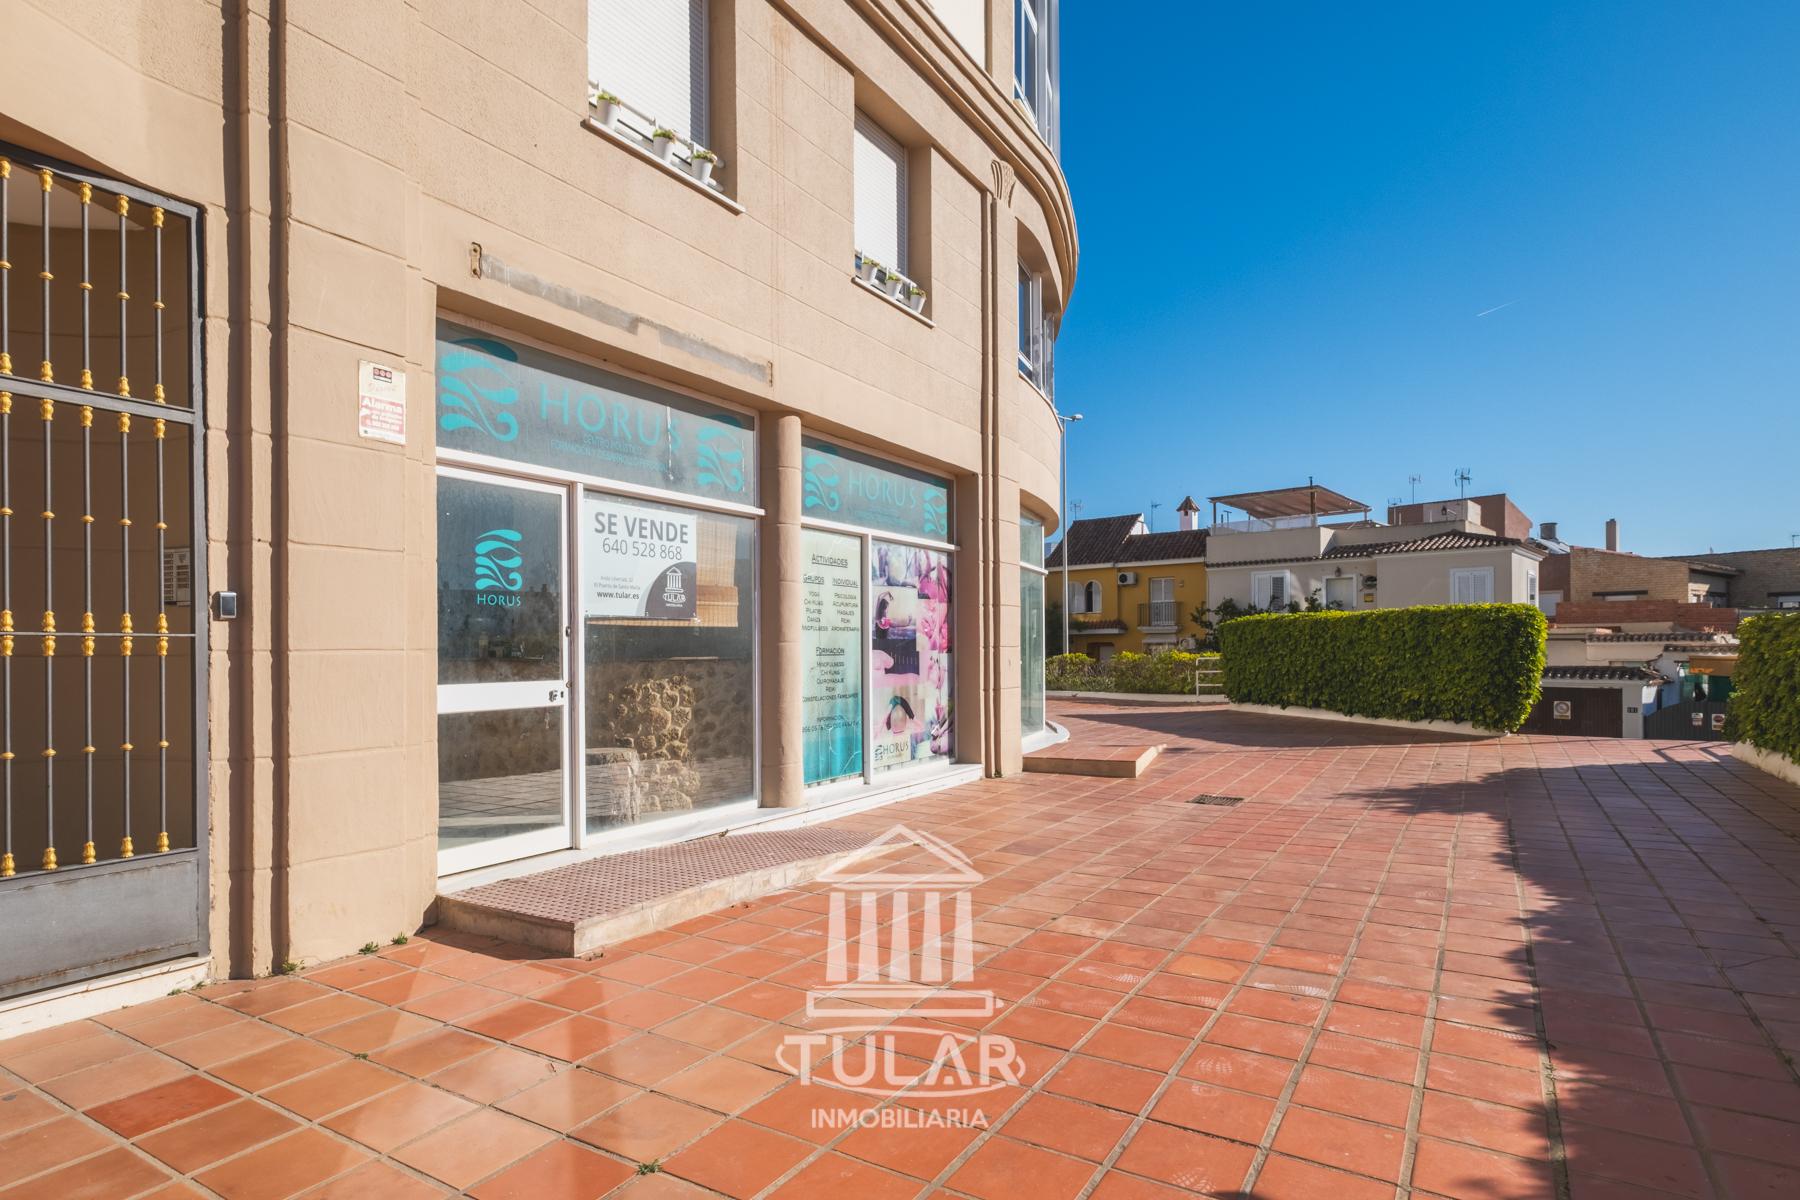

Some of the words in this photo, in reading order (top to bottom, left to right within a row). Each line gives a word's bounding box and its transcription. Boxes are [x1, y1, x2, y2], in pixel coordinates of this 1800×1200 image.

[538, 383, 682, 450] HORUS
[847, 472, 917, 508] HORUS
[594, 511, 618, 535] SE
[624, 515, 688, 544] VENDE
[602, 537, 628, 555] 640
[632, 541, 656, 558] 528
[660, 544, 683, 560] 868
[477, 593, 521, 607] HORUS
[596, 591, 640, 600] www.tular.es
[882, 741, 909, 754] HORUS
